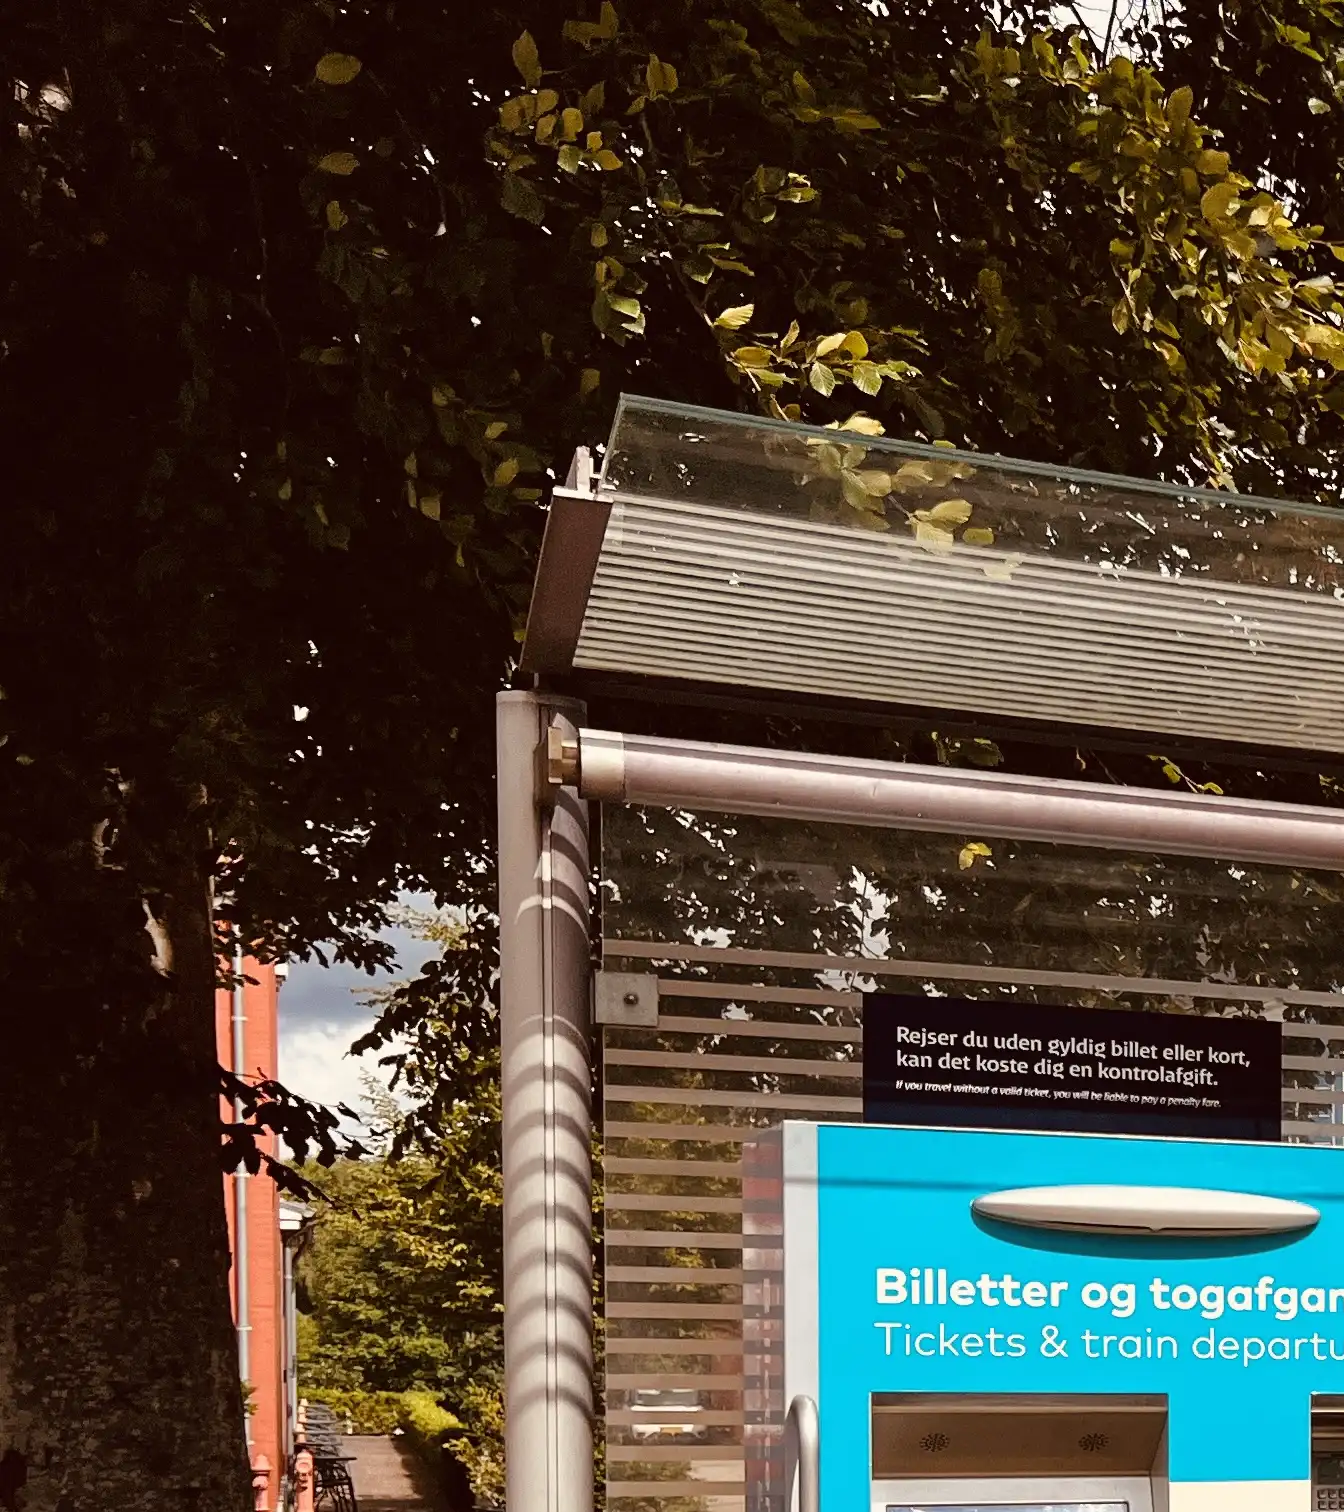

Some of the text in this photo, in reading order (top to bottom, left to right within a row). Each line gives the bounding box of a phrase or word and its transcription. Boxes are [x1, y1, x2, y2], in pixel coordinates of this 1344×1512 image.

[897, 1027, 1250, 1067] Rejser du uden gyldig billet eller kort,
[897, 1051, 1217, 1087] kan det koste dig en kontrolafgift.
[905, 1082, 922, 1090] you
[925, 1083, 952, 1092] travel
[953, 1084, 990, 1094] without
[1000, 1087, 1023, 1095] valid
[1024, 1088, 1051, 1098] ticket,
[1054, 1091, 1071, 1099] you
[1073, 1091, 1089, 1099] will
[1091, 1091, 1102, 1100] be
[1104, 1092, 1129, 1102] liable
[1141, 1096, 1158, 1105] pay
[1168, 1097, 1201, 1108] penalty
[877, 1268, 1068, 1306] Billetter
[1082, 1283, 1135, 1317] og
[875, 1323, 1025, 1356] Tickets
[1041, 1326, 1067, 1357] &
[1082, 1328, 1177, 1358] train
